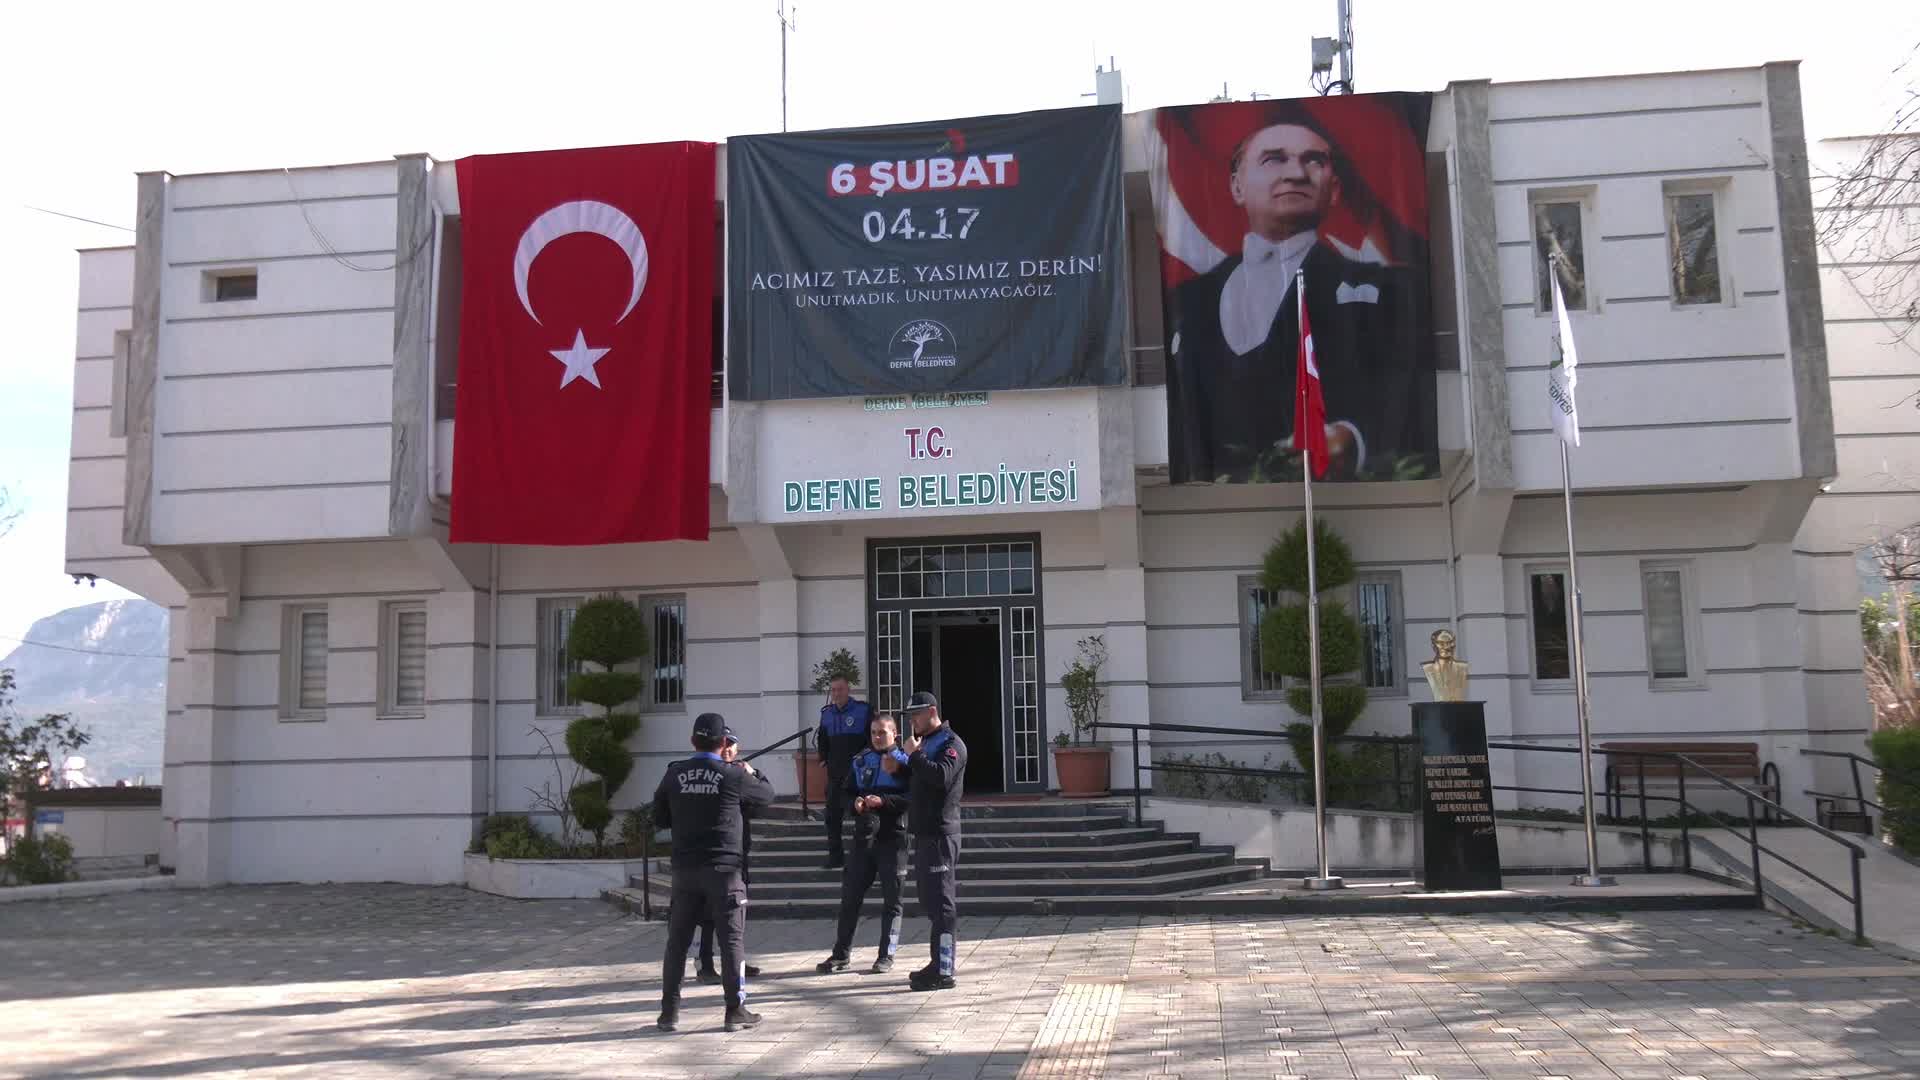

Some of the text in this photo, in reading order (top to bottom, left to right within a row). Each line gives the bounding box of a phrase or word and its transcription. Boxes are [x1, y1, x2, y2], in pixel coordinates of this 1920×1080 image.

[831, 154, 1013, 198] 6 ŞUBAT
[862, 207, 981, 243] 04.17
[751, 254, 1102, 291] ACIMIZ TAZE, YASIMIZ DERİN!
[905, 283, 1057, 303] UNUTMAYACAĞIZ.
[890, 361, 913, 369] DEFNE
[864, 396, 906, 411] DEFNE
[904, 426, 953, 460] T.C.
[784, 460, 1077, 514] DEFNE BELEDİYESİ
[678, 769, 724, 785] DEFNE
